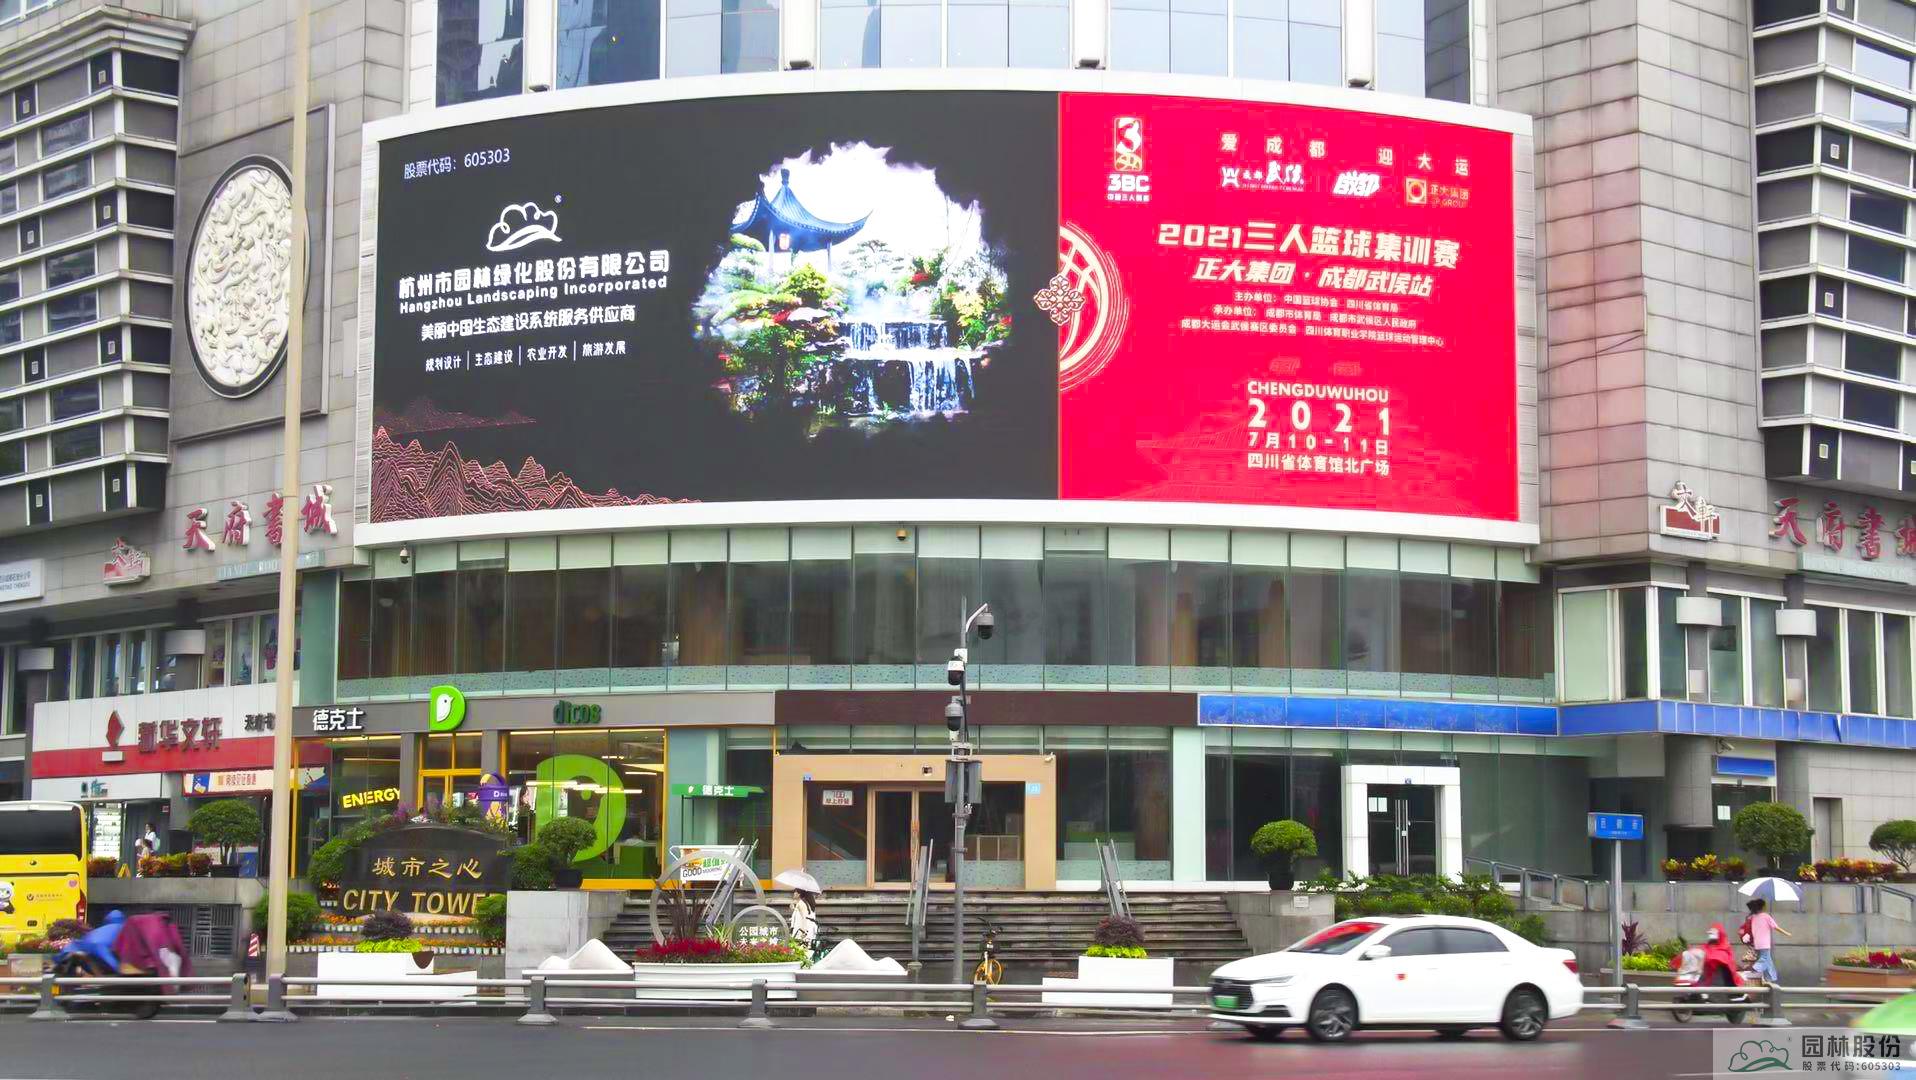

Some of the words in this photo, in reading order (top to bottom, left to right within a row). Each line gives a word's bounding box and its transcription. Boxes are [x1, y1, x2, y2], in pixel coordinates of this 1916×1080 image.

[403, 156, 457, 180] 股票代码：
[463, 148, 511, 168] 605303
[1221, 133, 1325, 158] 爱成都
[1378, 148, 1469, 176] 迎大运
[1107, 173, 1151, 192] 3BC
[1157, 221, 1461, 270] 2021三人篮球集训赛
[398, 250, 670, 300] 杭州市园林绿化股份有限公司
[400, 297, 463, 314] Hangzhou
[467, 287, 558, 306] Landscaping
[564, 275, 668, 296] Incorporated
[421, 303, 636, 342] 美丽中国生态建设系统服务供应商
[425, 355, 462, 372] 规划设计
[475, 349, 513, 367] 生态建设
[527, 344, 568, 361] 农业开发
[582, 340, 626, 357] 旅游发展
[1247, 380, 1389, 403] CHENGDUWUHOU
[1247, 397, 1390, 436] 2021
[1248, 432, 1389, 456] 7月10-11日
[1247, 452, 1390, 476] 四川省体育馆北广场
[312, 707, 364, 731] 德克士
[342, 787, 400, 808] ENERGY
[702, 785, 735, 797] 德克士
[371, 857, 483, 879] 城市之心
[683, 866, 703, 878] GOOD
[343, 889, 400, 912] CITY
[411, 891, 496, 915] TOWE
